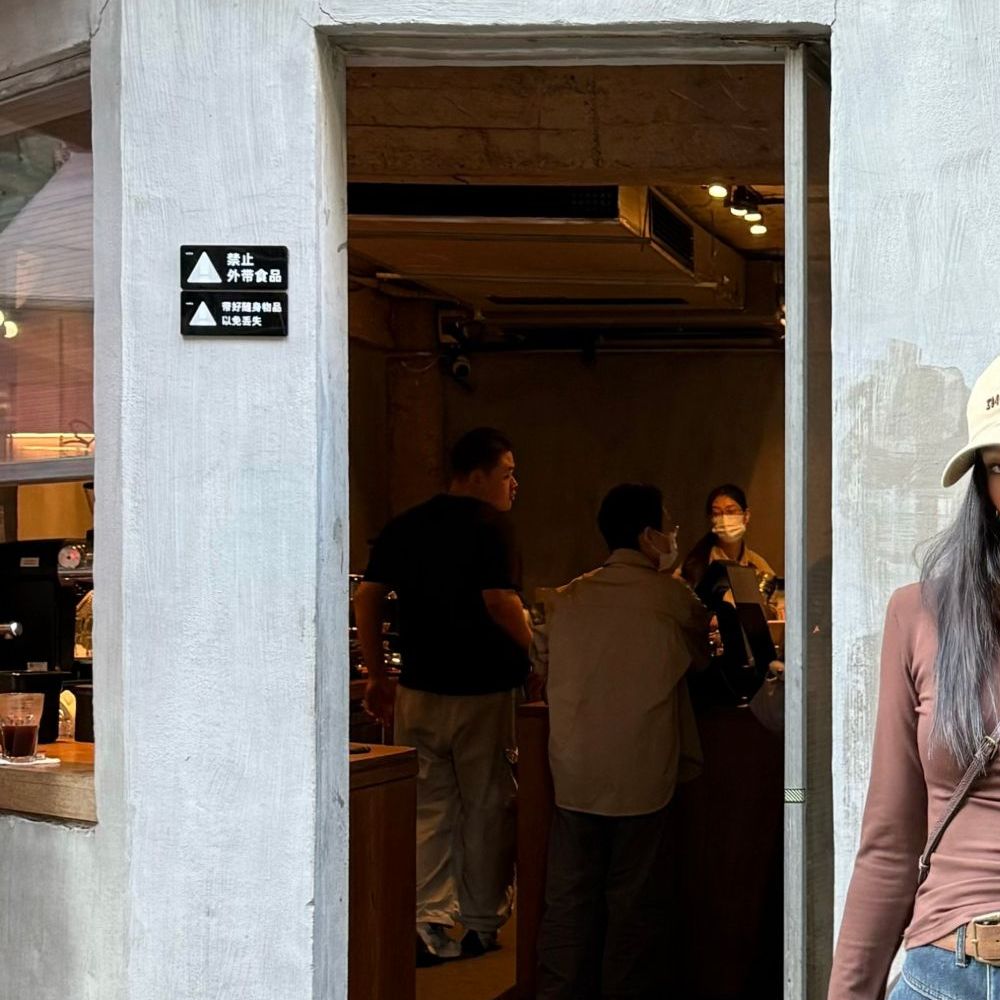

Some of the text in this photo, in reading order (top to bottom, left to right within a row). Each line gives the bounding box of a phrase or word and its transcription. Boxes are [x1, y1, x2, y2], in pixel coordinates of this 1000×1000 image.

[226, 252, 254, 267] 禁止
[226, 268, 282, 283] 外带食品
[221, 315, 262, 327] 以免丢失
